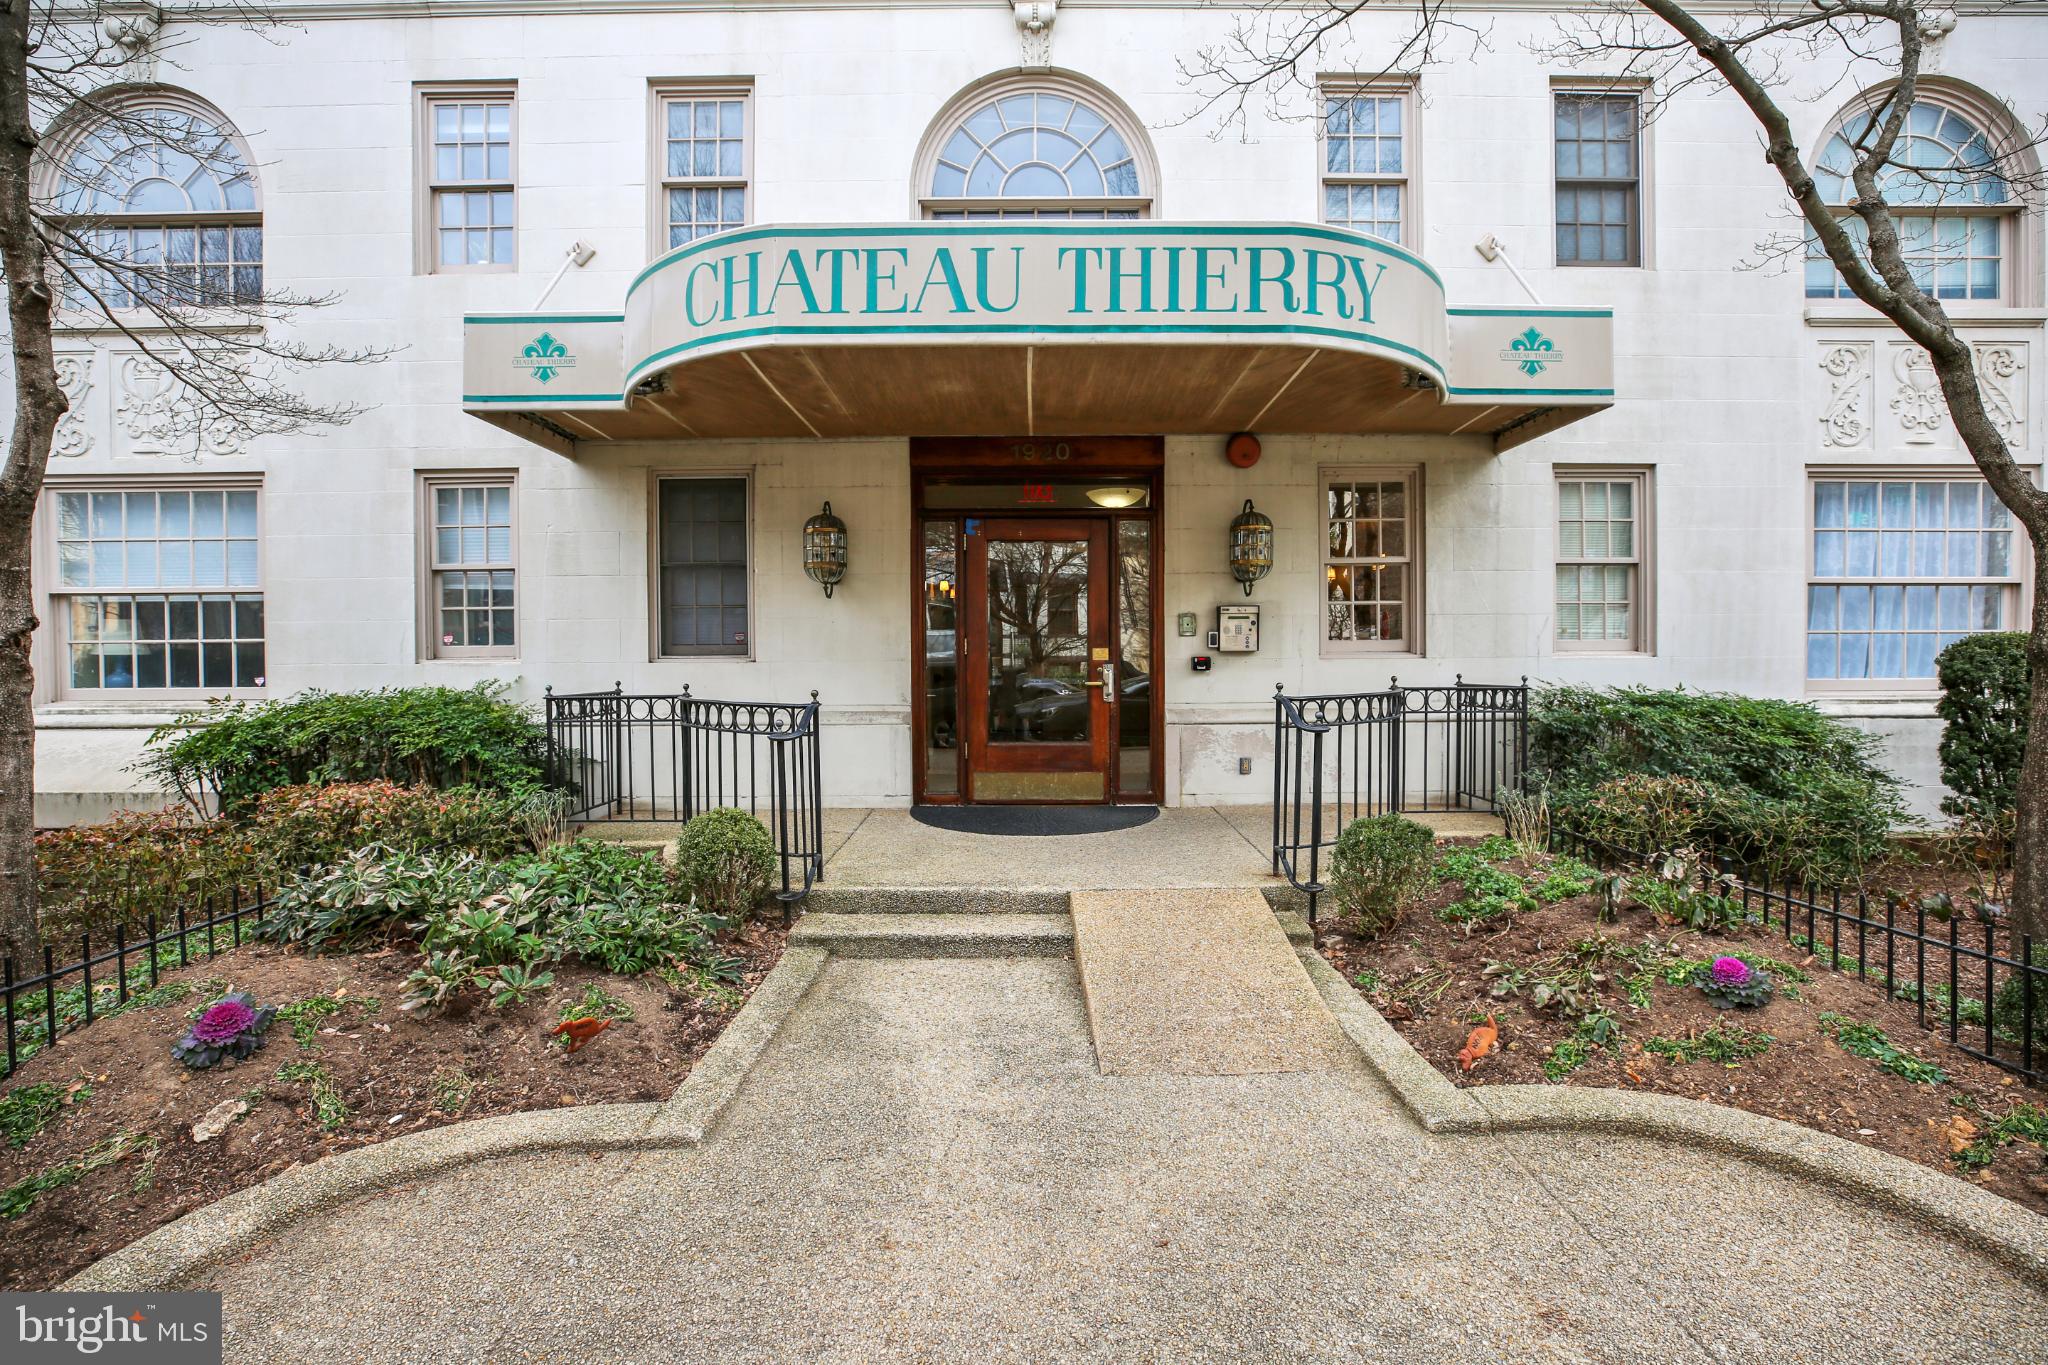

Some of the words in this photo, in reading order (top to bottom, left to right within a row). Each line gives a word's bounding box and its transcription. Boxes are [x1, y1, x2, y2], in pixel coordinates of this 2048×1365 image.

[684, 247, 1025, 327] CHATEAU
[1058, 247, 1387, 324] THIERRY
[1010, 443, 1070, 460] 1920
